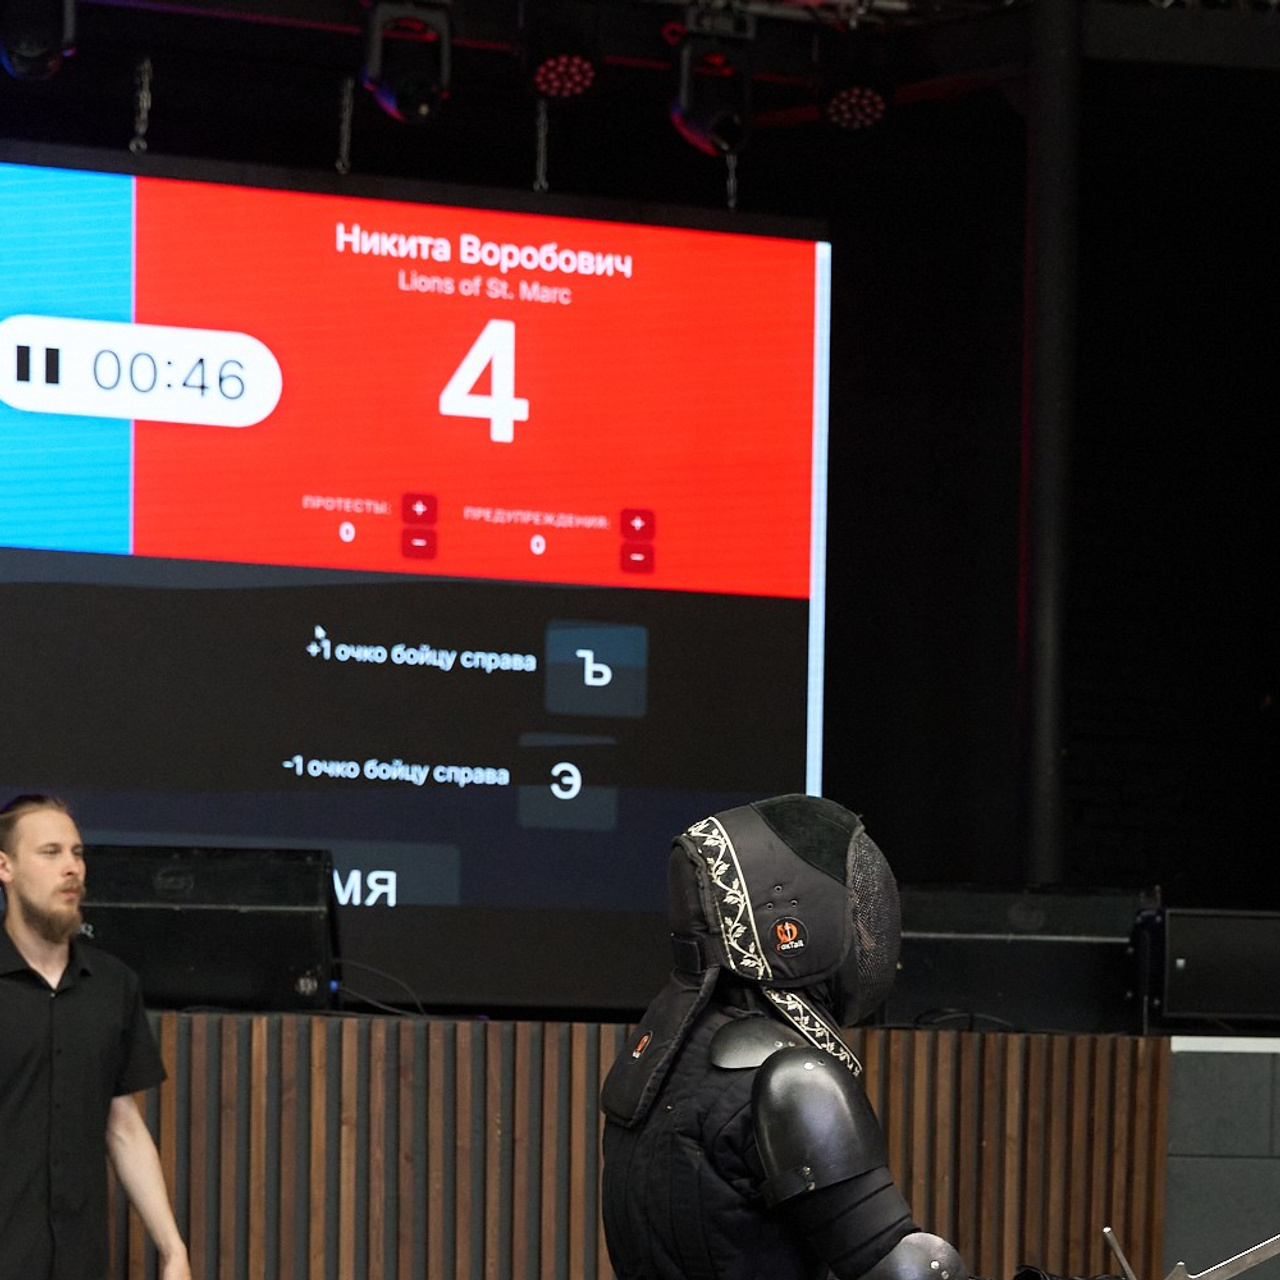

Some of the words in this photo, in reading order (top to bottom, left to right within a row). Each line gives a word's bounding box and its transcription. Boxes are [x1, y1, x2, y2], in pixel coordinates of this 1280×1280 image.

[335, 222, 452, 262] Никита
[459, 233, 633, 278] Воробович
[398, 269, 456, 295] Lions
[459, 275, 483, 297] of
[486, 278, 515, 299] St.
[519, 280, 572, 305] Marc
[92, 349, 247, 401] 00:46
[439, 318, 530, 444] 4
[302, 495, 391, 516] ПРОТЕСТЫ:
[339, 521, 356, 543] 0
[530, 534, 547, 556] 0
[306, 638, 332, 661] +1
[334, 643, 388, 664] очко
[390, 643, 457, 672] бойцу
[459, 650, 538, 674] справа
[575, 649, 613, 687] Ъ
[282, 755, 304, 776] -1
[307, 760, 361, 780] очко
[363, 759, 430, 787] бойцу
[432, 764, 511, 788] справа
[550, 761, 583, 800] Э
